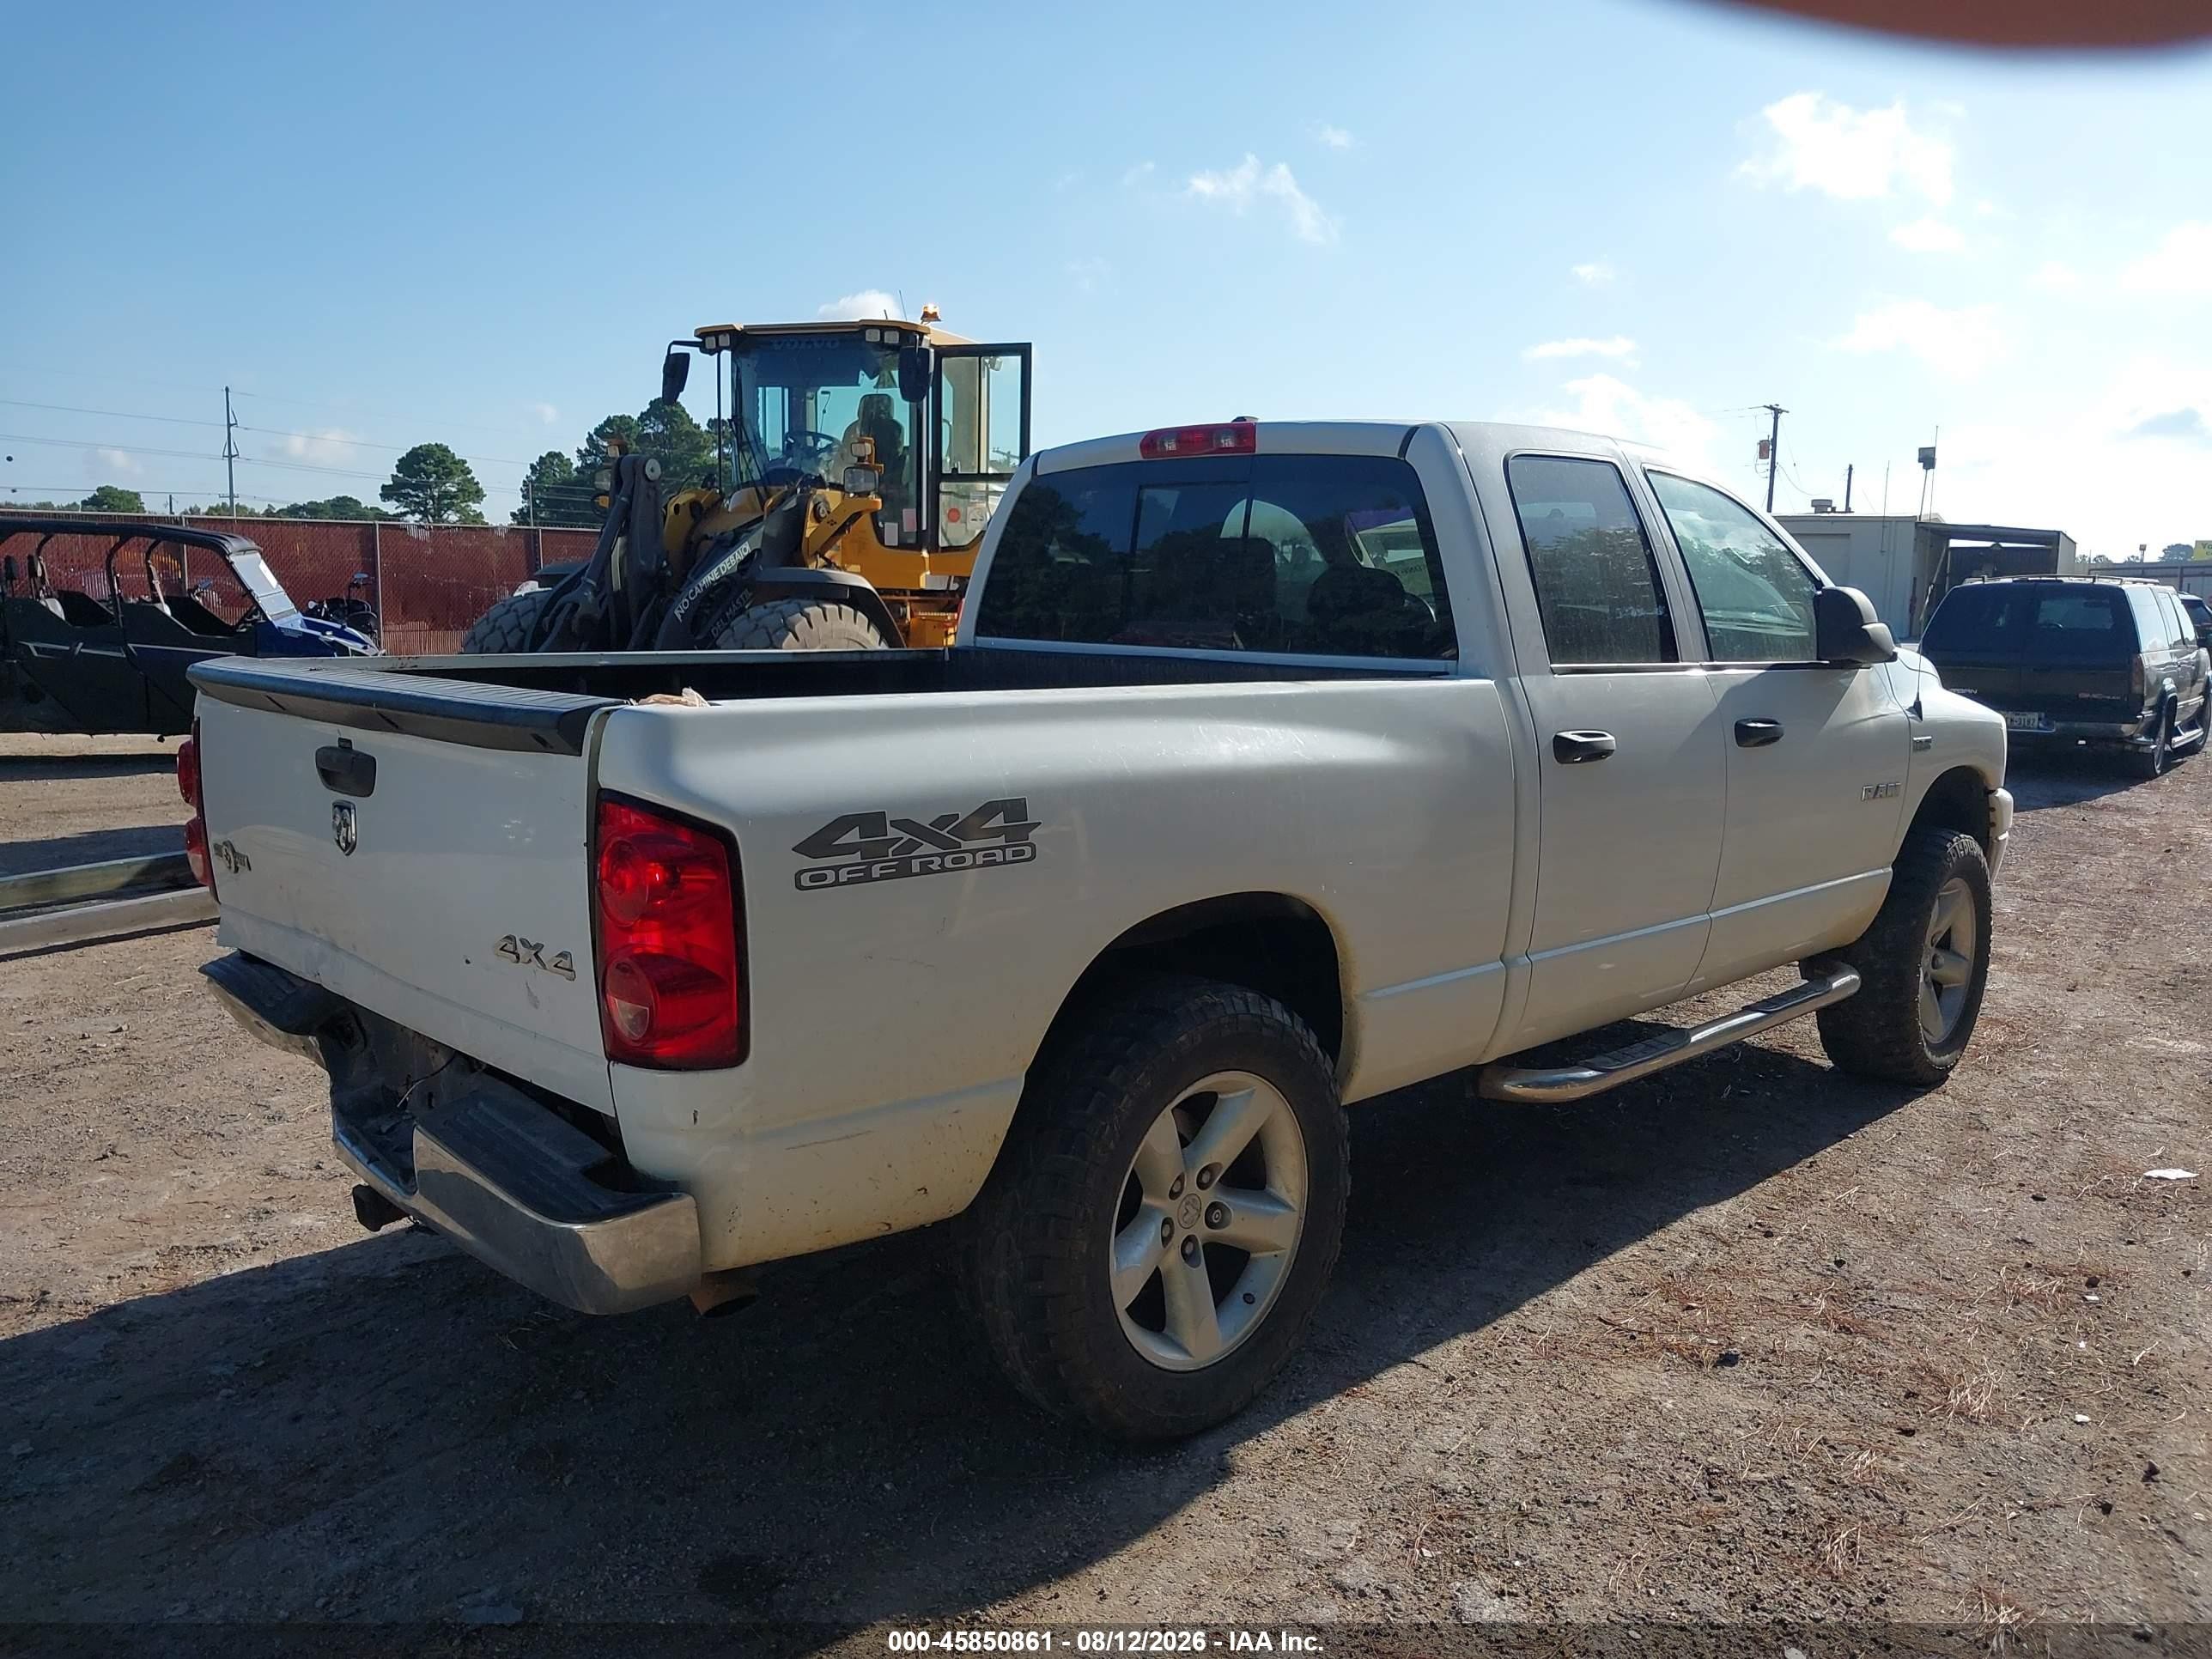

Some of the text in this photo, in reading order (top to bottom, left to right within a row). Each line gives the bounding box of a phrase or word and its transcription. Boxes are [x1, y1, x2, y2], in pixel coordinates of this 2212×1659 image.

[689, 568, 720, 600] CAMINE
[712, 618, 727, 637] DEL
[1861, 782, 1901, 802] RAM
[799, 845, 1032, 888] OFF ROAD
